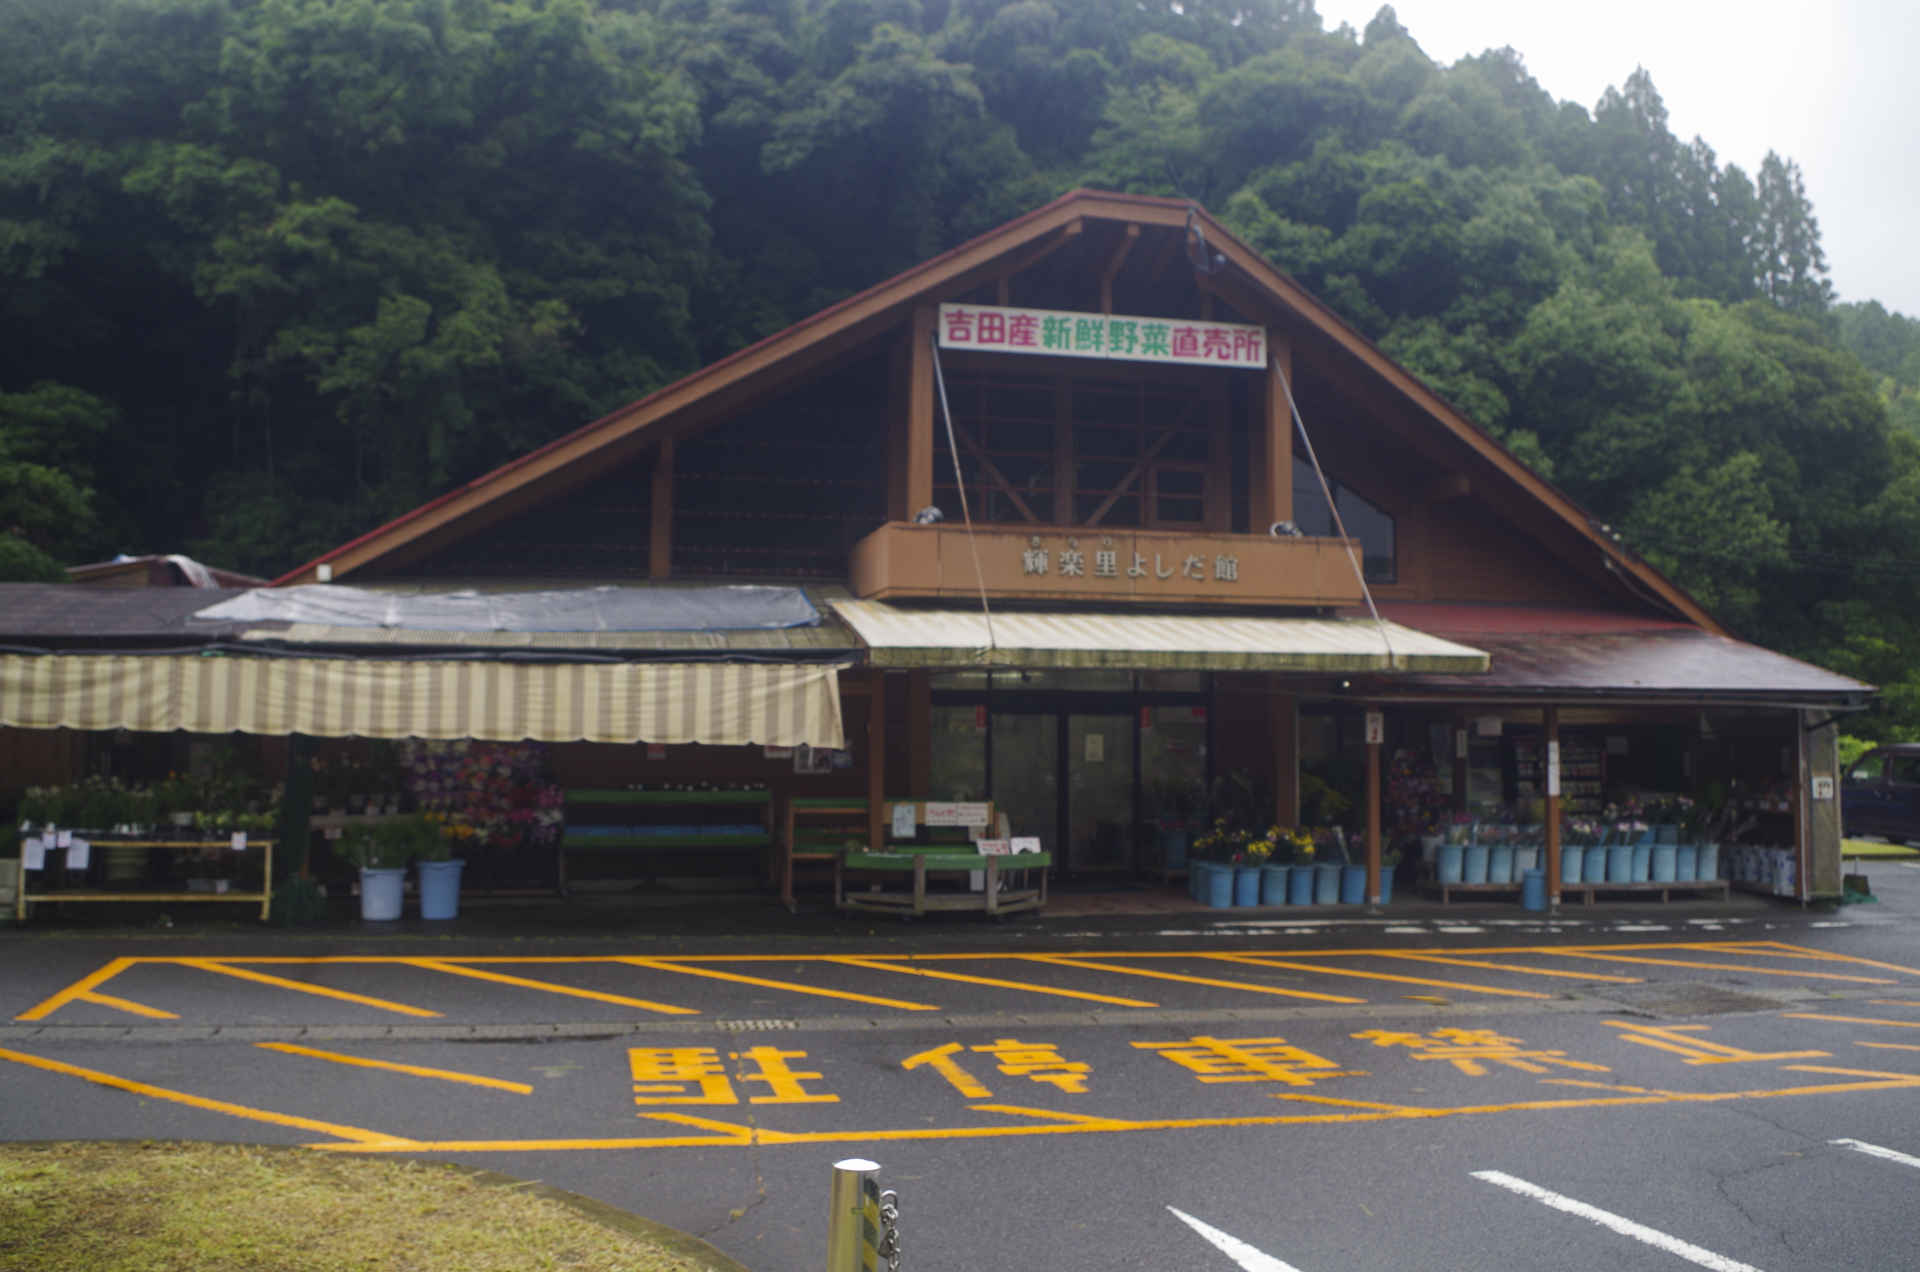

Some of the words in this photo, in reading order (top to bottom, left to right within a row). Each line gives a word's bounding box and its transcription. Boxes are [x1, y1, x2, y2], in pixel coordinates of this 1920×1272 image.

[944, 309, 1262, 362] 吉田産新鮮野菜直売所
[1030, 536, 1113, 548] きらり
[1023, 549, 1239, 582] 輝楽里よしだ館
[628, 1020, 1834, 1105] 駐停車禁止
